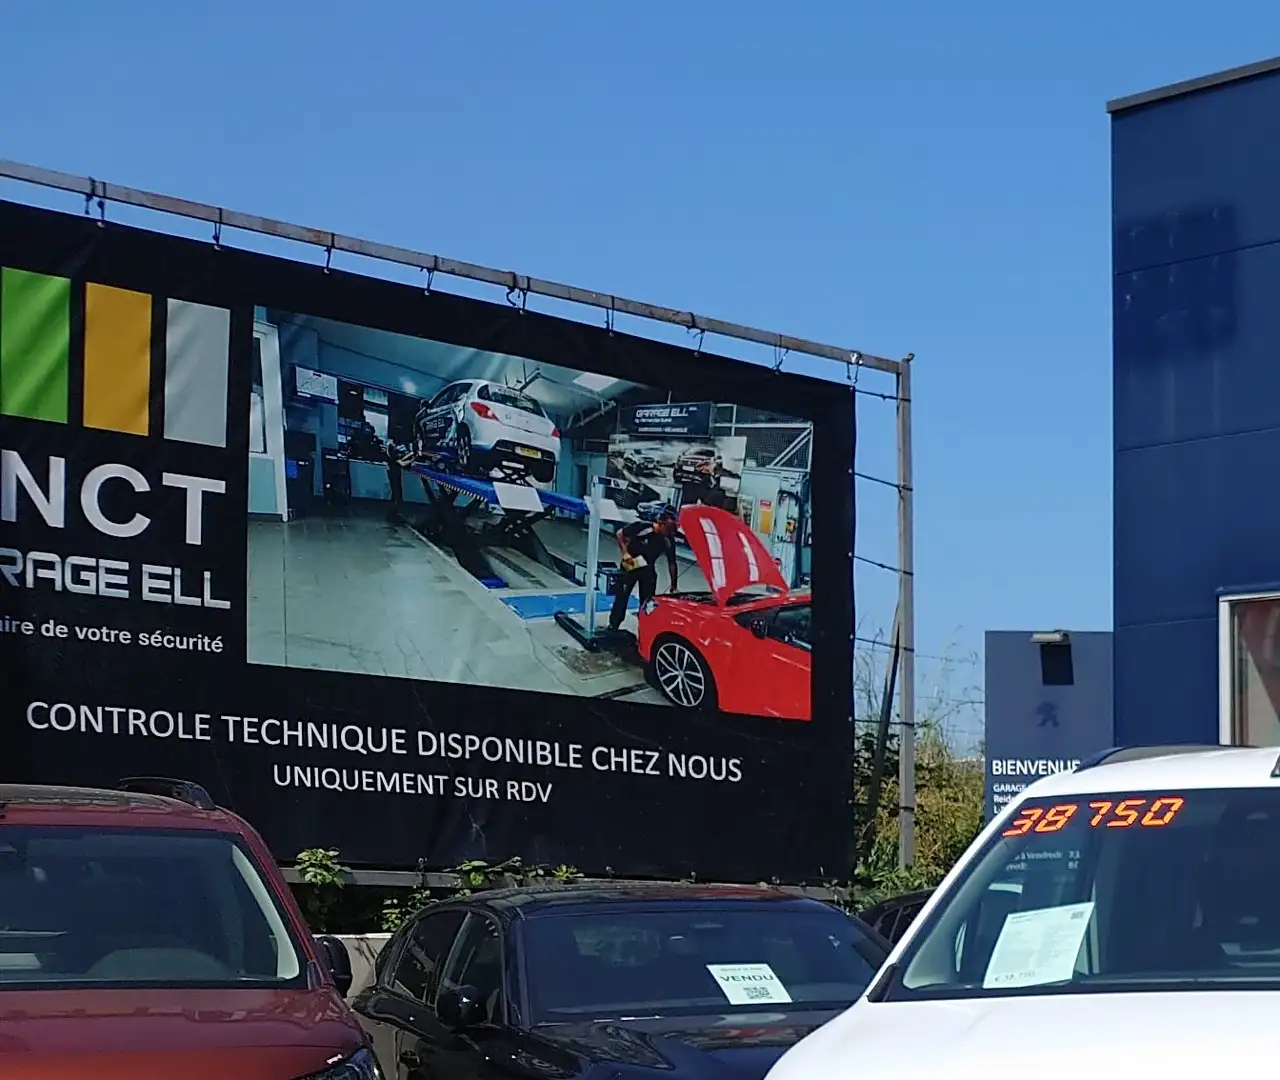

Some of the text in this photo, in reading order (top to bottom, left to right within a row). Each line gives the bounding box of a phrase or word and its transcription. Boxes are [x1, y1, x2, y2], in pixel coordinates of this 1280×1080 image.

[1, 449, 226, 546] NCT
[142, 564, 231, 609] ELL
[0, 615, 223, 653] ire de votre sécurité
[26, 701, 743, 782] CONTROLE TECHNIQUE DISPONIBLE CHEZ NOUS
[273, 764, 553, 803] UNIQUEMENT SUR RDV
[1002, 797, 1185, 837] 38 750
[720, 974, 774, 982] VENDU
